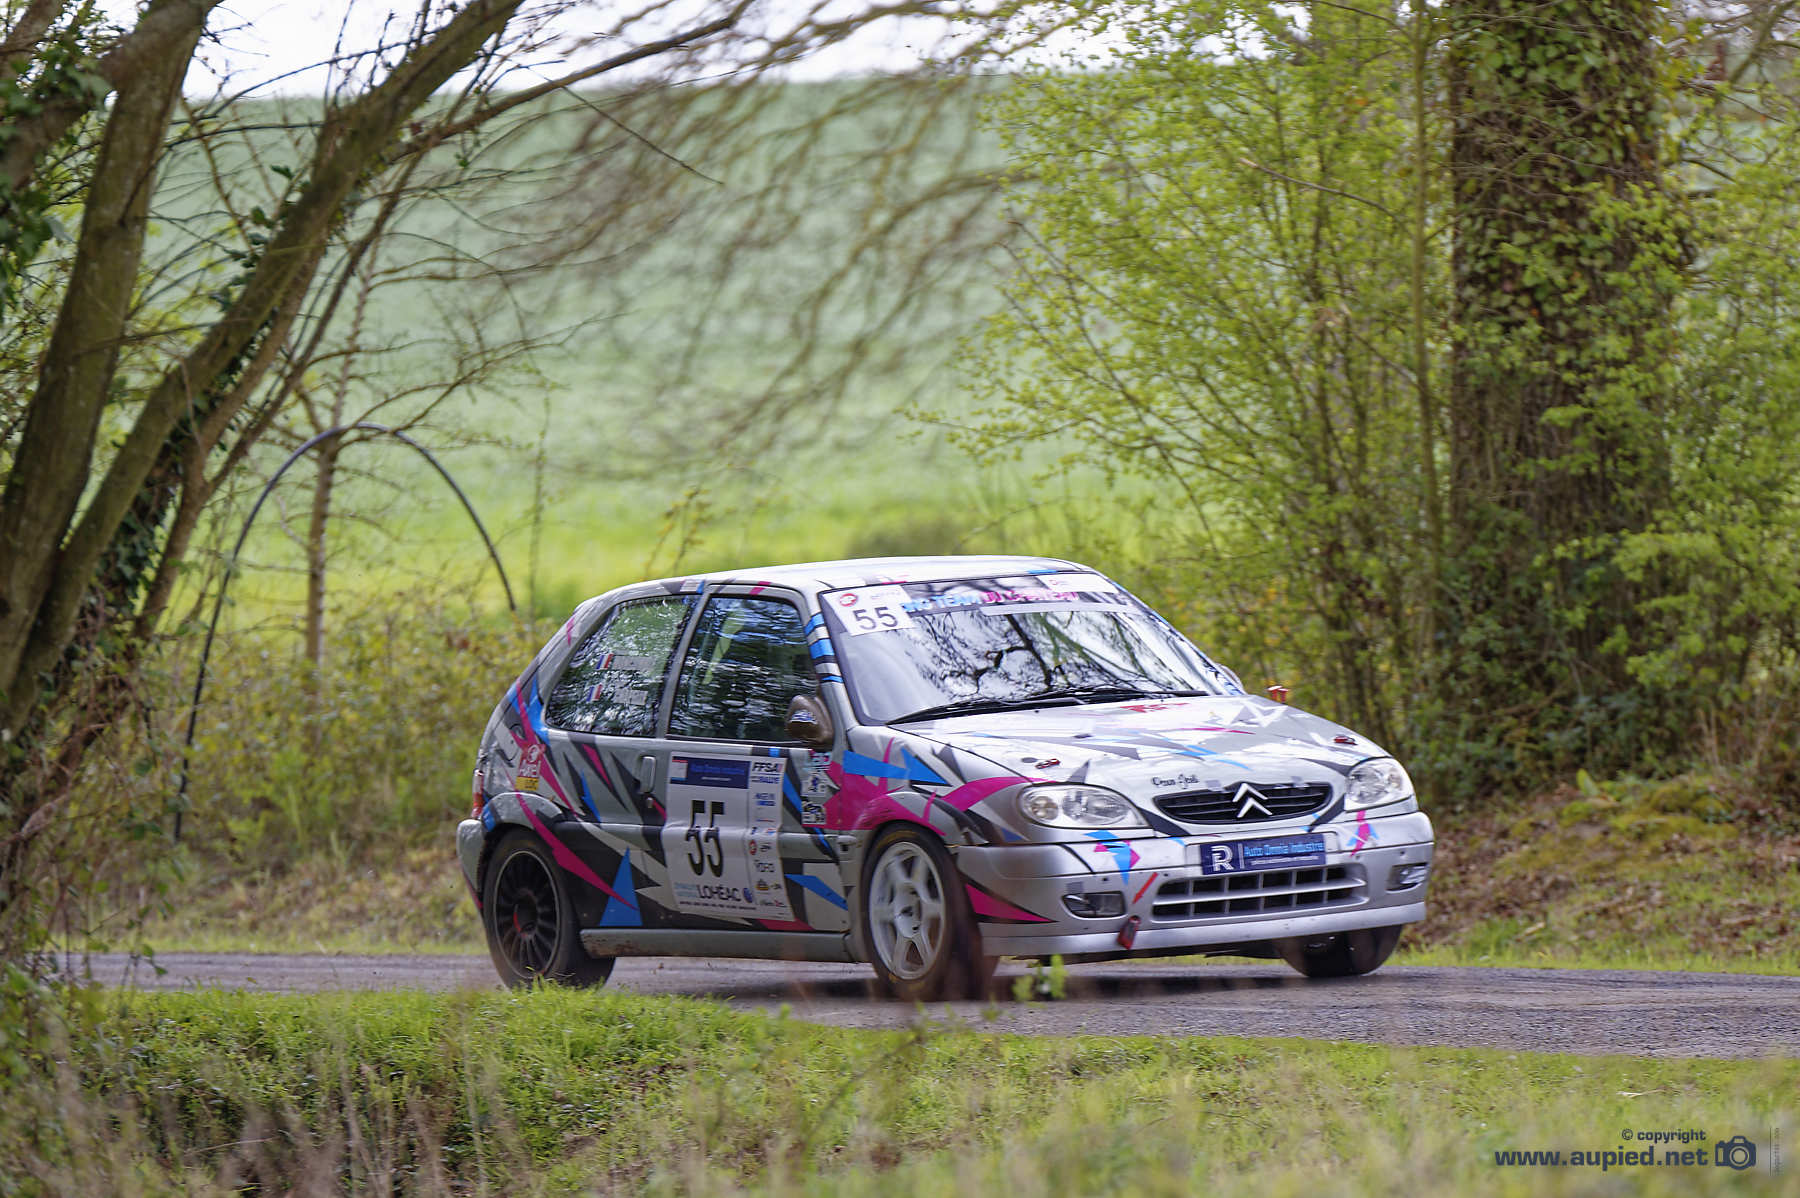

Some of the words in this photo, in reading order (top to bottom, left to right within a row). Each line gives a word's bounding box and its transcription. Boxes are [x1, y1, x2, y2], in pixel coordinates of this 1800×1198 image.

[852, 606, 898, 630] 55
[752, 762, 778, 774] FFSA
[685, 799, 724, 877] 55
[696, 885, 742, 902] LOHÉAC
